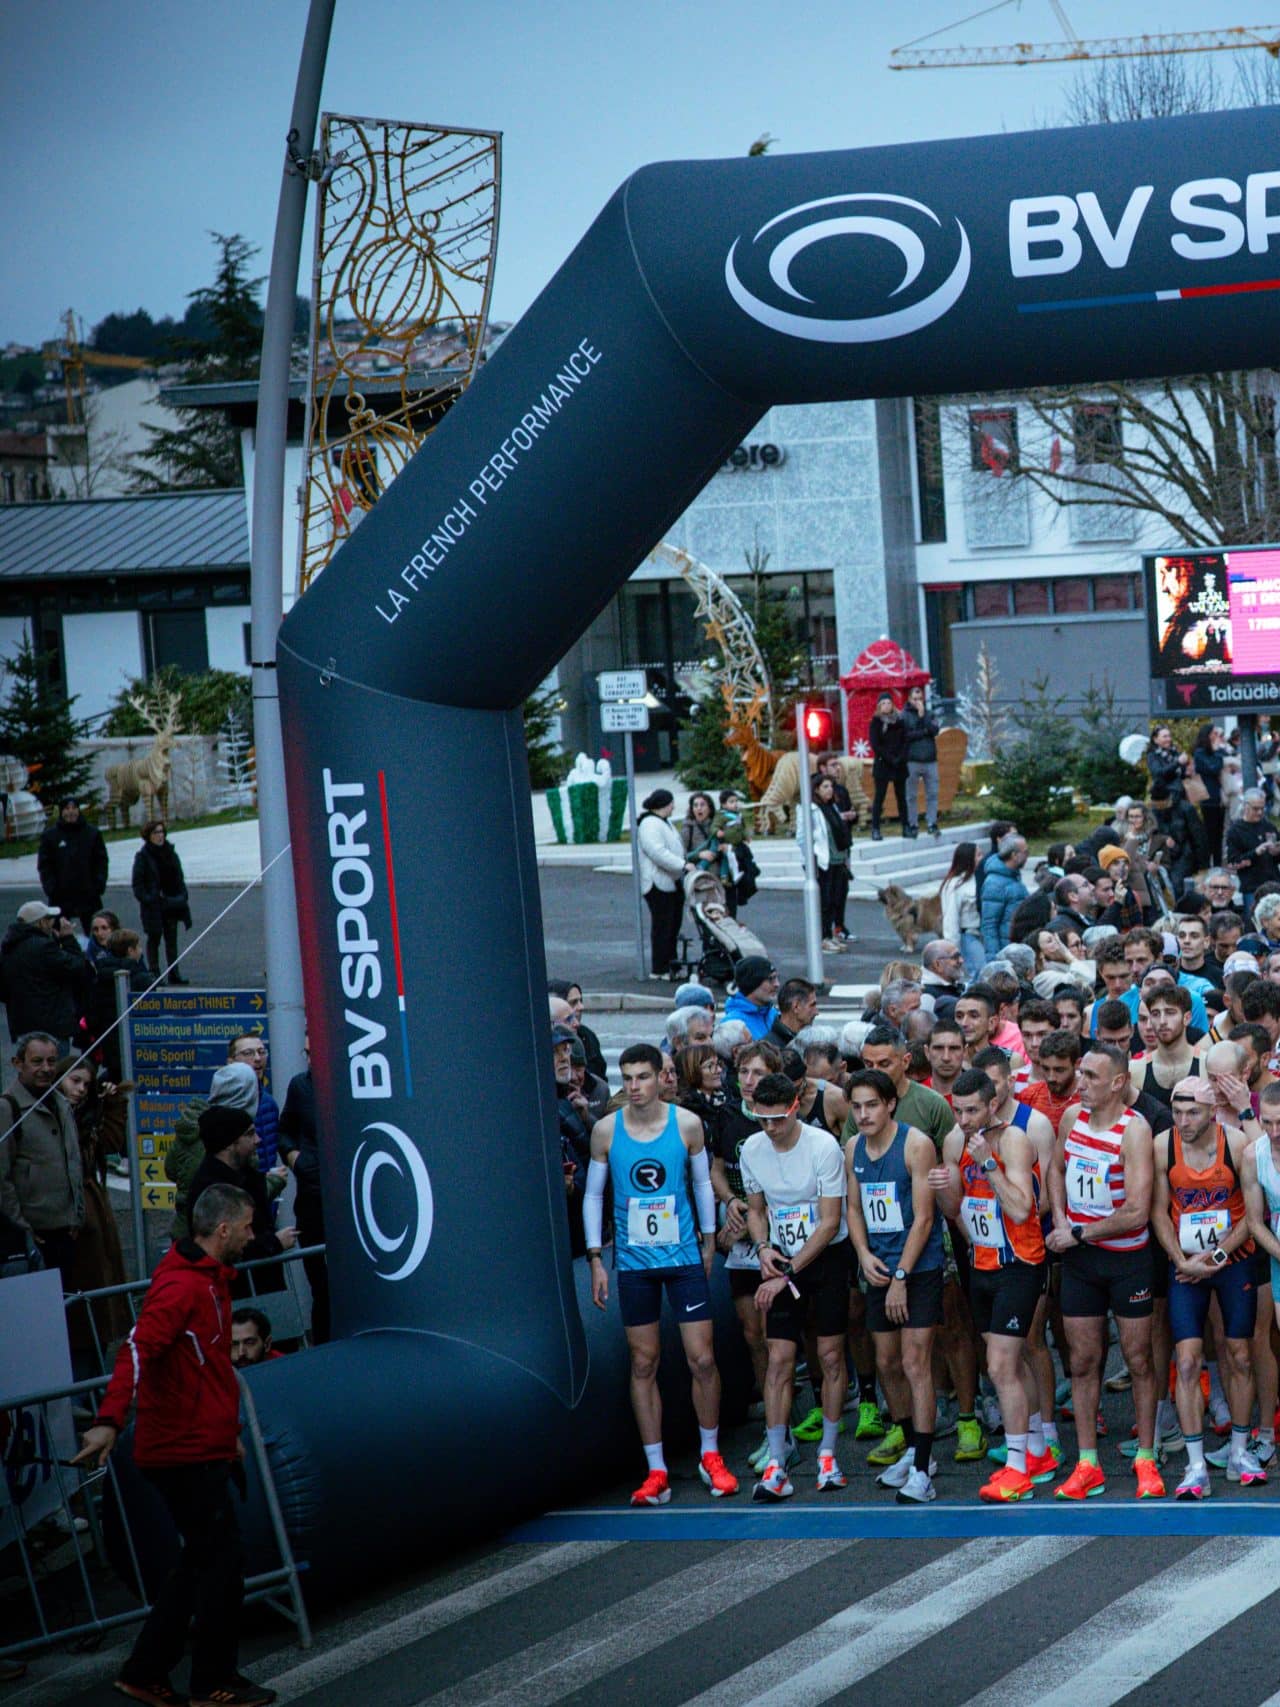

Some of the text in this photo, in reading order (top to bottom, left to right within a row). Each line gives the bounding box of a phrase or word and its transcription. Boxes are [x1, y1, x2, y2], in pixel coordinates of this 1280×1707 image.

[1008, 185, 1155, 278] BV
[375, 337, 602, 624] LA FRENCH PERFORMANCE
[323, 768, 392, 1099] BV SPORT
[163, 996, 197, 1010] Marcel
[198, 996, 236, 1010] THINET
[133, 1022, 244, 1038] Bibliothèque Municipale
[135, 1047, 196, 1063] Pôle Sportif
[137, 1073, 192, 1087] Pôle Festif
[139, 1100, 175, 1113] Maison
[153, 1116, 166, 1128] de
[1076, 1174, 1095, 1200] 11
[868, 1198, 887, 1223] 10
[646, 1213, 658, 1236] 6
[777, 1220, 809, 1247] 654
[970, 1213, 990, 1237] 16
[1194, 1227, 1220, 1251] 14
